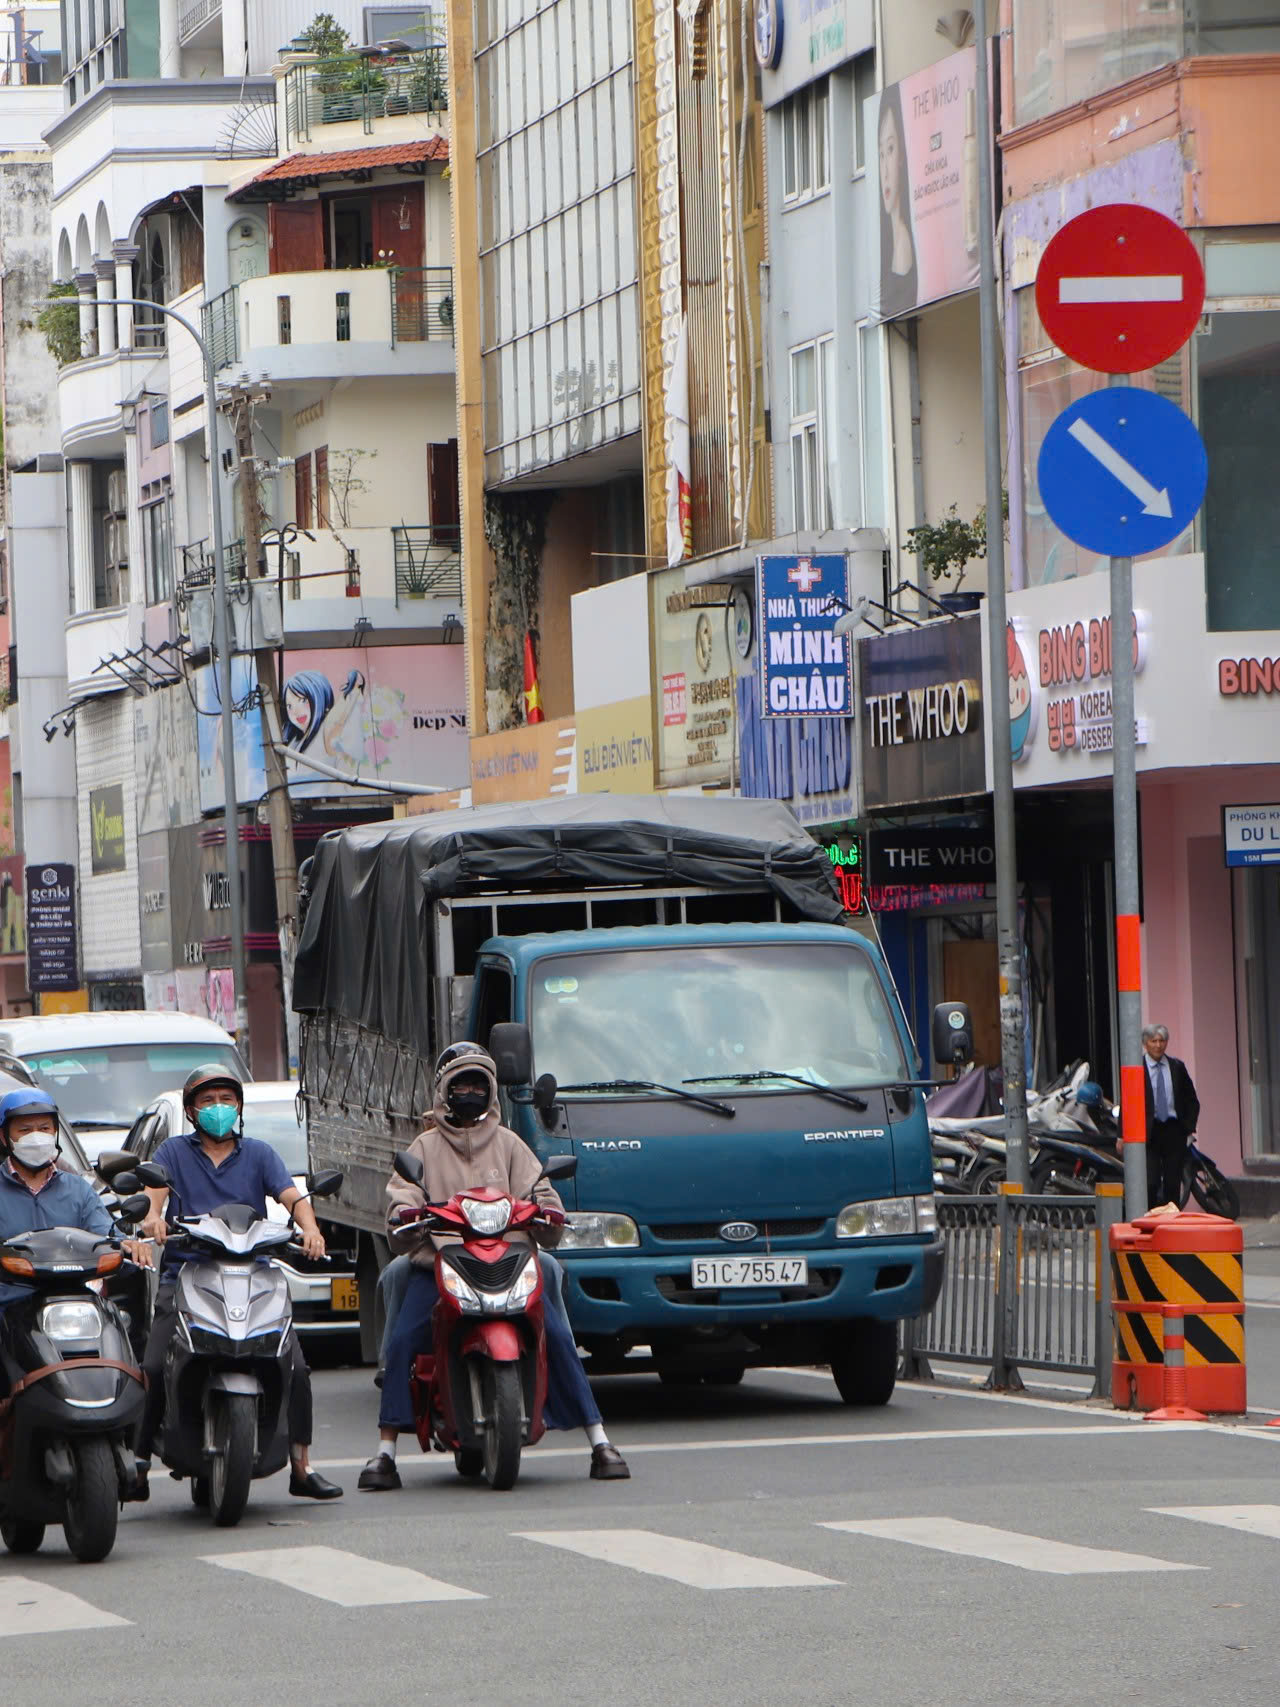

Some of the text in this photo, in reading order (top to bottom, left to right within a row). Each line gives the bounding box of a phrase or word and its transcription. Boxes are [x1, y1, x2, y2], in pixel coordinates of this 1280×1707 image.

[912, 77, 960, 119] THE WHOO
[767, 594, 797, 618] NHÀ
[1039, 609, 1139, 688] BING BI
[769, 667, 845, 712] CHÂU
[865, 679, 969, 748] THE WHOO
[1047, 696, 1076, 752] 빙빙
[1229, 810, 1267, 822] PHÒNG
[1241, 827, 1265, 842] DU
[883, 847, 931, 868] THE
[1243, 854, 1260, 863] 15M
[31, 884, 70, 904] genki
[581, 1140, 642, 1152] THACO
[803, 1129, 885, 1143] FRONTIER
[726, 1225, 751, 1238] KIA
[52, 1264, 84, 1272] HONDA
[696, 1261, 804, 1285] 51C-755.47
